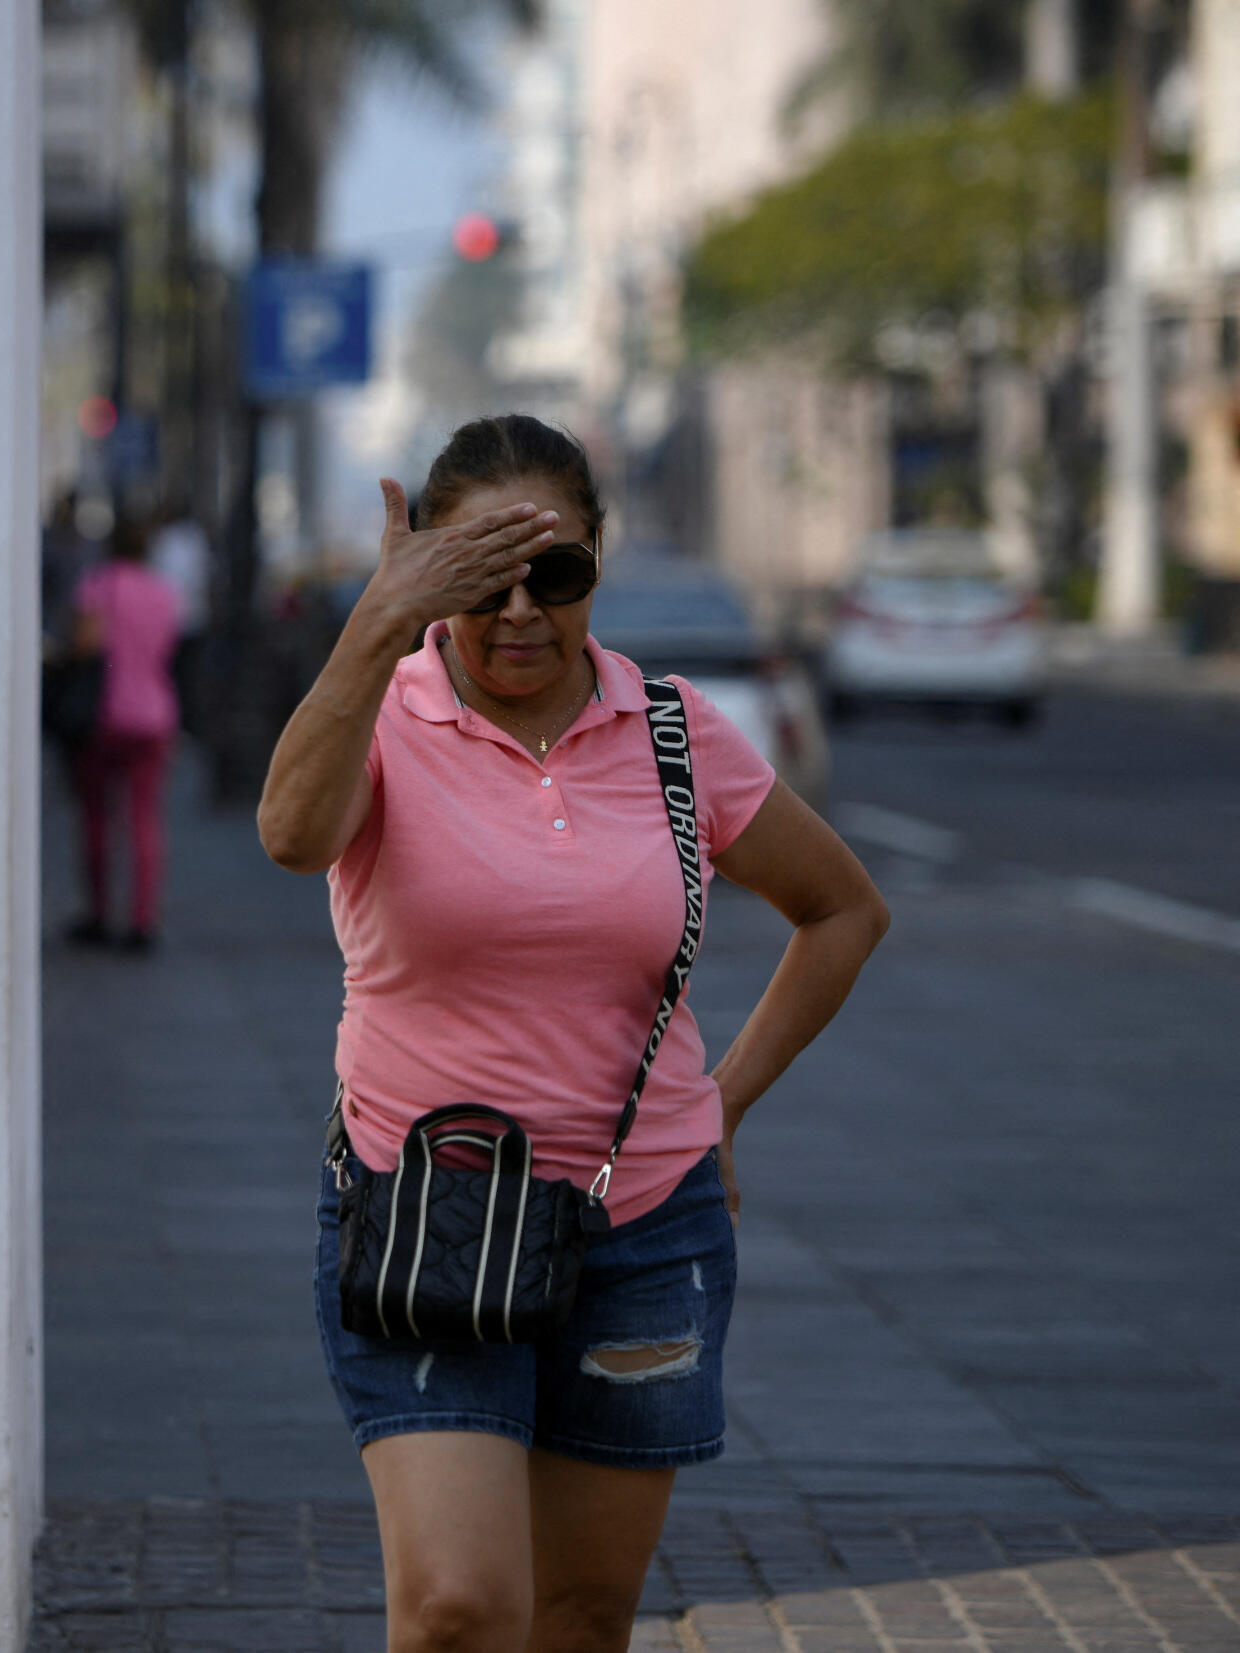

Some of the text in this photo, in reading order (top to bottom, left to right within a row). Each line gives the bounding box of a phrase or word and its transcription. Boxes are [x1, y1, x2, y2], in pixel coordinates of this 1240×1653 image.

[649, 700, 691, 774] NOT
[664, 784, 702, 991] ORDINARY
[642, 997, 674, 1083] NOT
